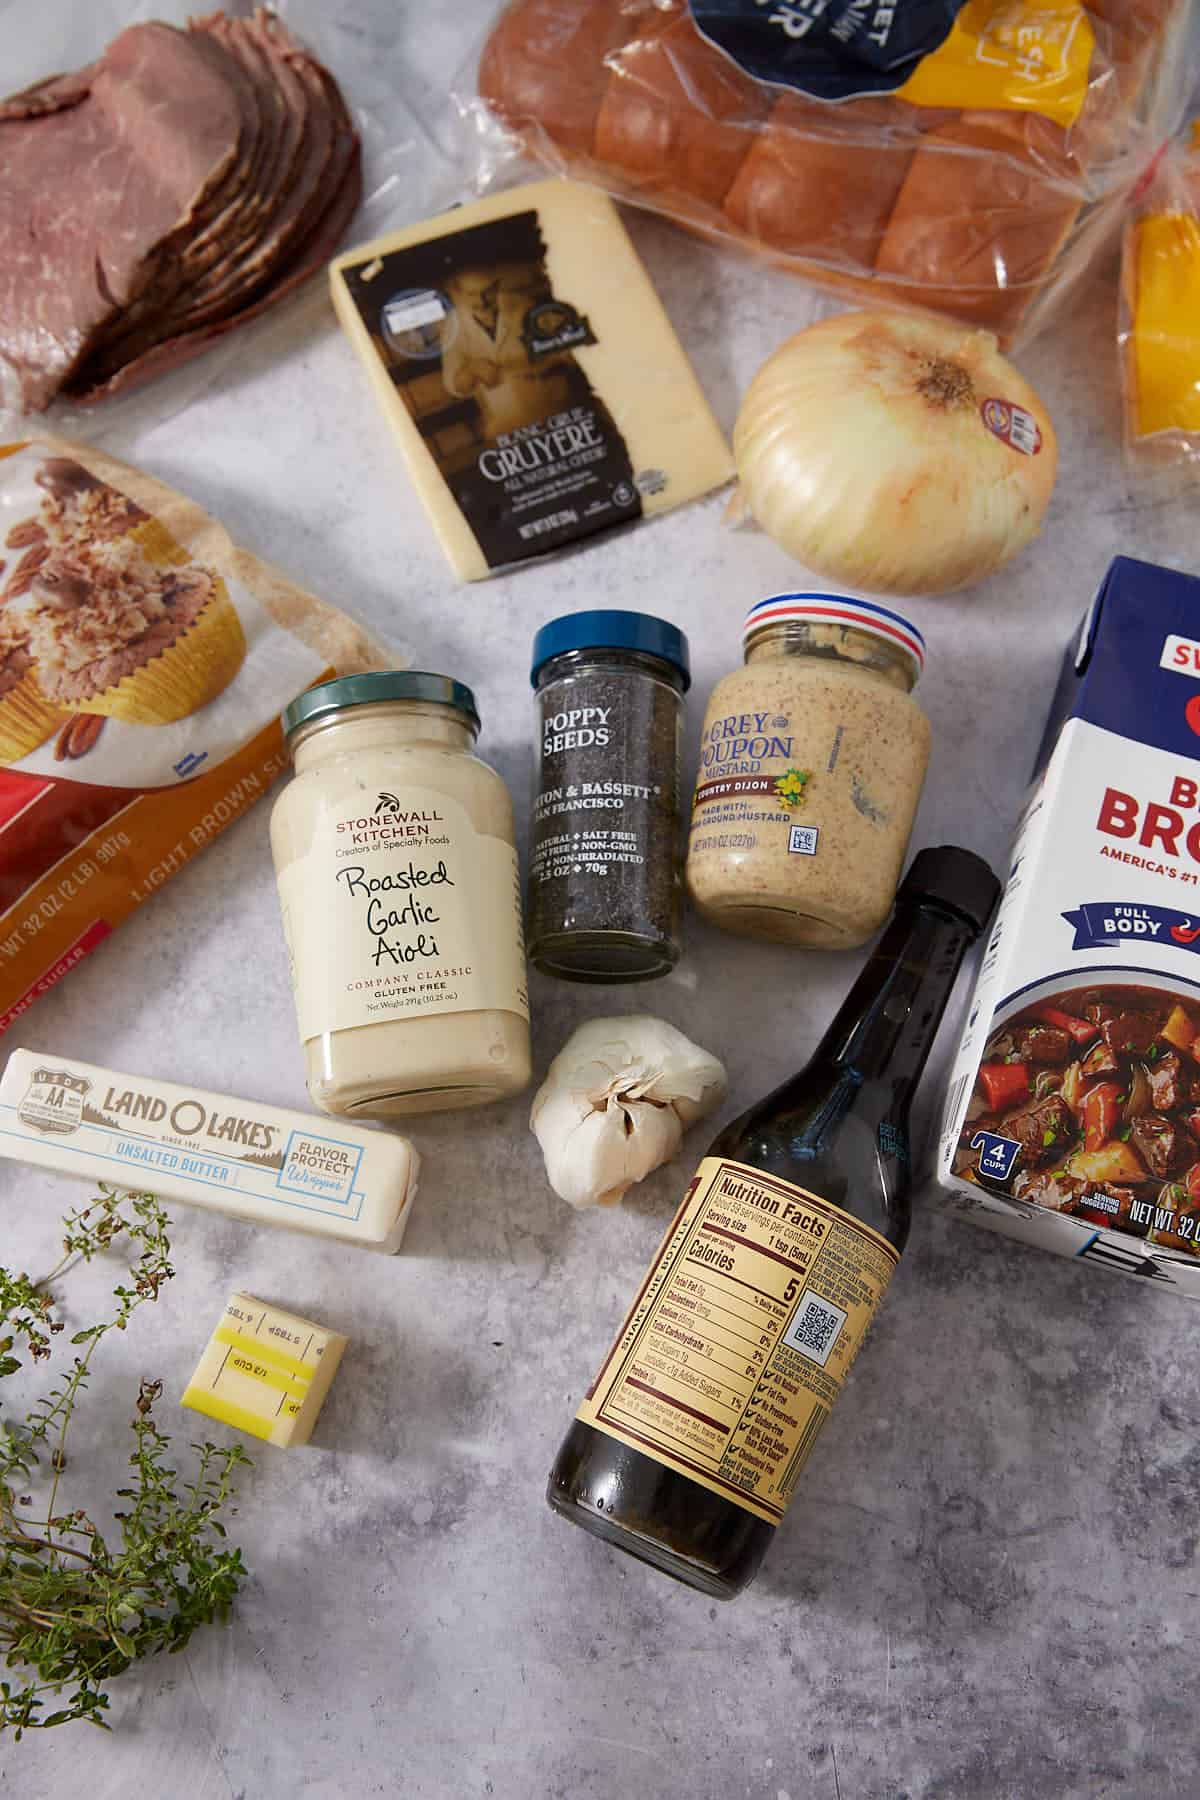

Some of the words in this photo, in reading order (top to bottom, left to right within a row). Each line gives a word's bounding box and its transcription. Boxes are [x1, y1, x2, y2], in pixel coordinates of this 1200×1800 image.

[544, 707, 611, 736] POPPY
[711, 712, 768, 742] GREY
[543, 727, 610, 757] SEEDS
[704, 736, 794, 767] OUPON
[566, 785, 578, 797] &
[698, 783, 731, 799] COUNTRY
[735, 781, 768, 790] DIJON
[552, 798, 624, 815] FRANCISCO
[724, 801, 747, 811] WITH
[336, 811, 444, 833] STONEWALL
[736, 812, 790, 823] MUSTARD
[131, 840, 188, 901] LIGHT
[189, 773, 260, 846] BROWN
[352, 825, 429, 844] KITCHEN
[583, 831, 609, 840] SALT
[611, 831, 637, 842] FREE
[336, 843, 370, 858] Creators
[373, 841, 381, 851] of
[383, 837, 423, 850] Specialty
[425, 835, 449, 845] Foods
[581, 841, 637, 851] NON-GMO
[553, 852, 643, 865] NON-IRRADIATED
[1100, 845, 1177, 879] AMERICA'S
[1180, 872, 1198, 885] #1
[336, 861, 455, 897] Roasted
[554, 866, 570, 877] OZ
[585, 863, 608, 875] 70g
[3, 934, 27, 957] WT
[23, 914, 46, 936] 32
[40, 895, 64, 918] OZ
[58, 878, 76, 901] (2
[72, 859, 100, 885] LB)
[96, 831, 131, 863] 907g
[367, 893, 440, 935] Garlic
[1114, 907, 1150, 919] FULL
[1104, 918, 1162, 935] BODY
[372, 935, 440, 966] Aioli
[37, 947, 85, 991] SUGAR
[347, 974, 410, 991] COMPANY
[417, 967, 472, 980] CLASSIC
[375, 985, 416, 998] GLUTEN
[420, 982, 447, 992] FREE
[379, 999, 404, 1011] Weight
[45, 1086, 64, 1108] AA
[102, 1087, 167, 1122] LAND
[170, 1100, 206, 1135] O
[207, 1112, 275, 1149] LAKES
[116, 1143, 178, 1168] UNSALTED
[181, 1159, 229, 1180] BUTTER
[299, 1142, 348, 1163] FLAVOR
[990, 1144, 1006, 1160] 4
[984, 1159, 1005, 1171] CUPS
[721, 1176, 780, 1214] Nutrition
[782, 1205, 826, 1236] Facts
[1080, 1196, 1119, 1214] SUGGESTION
[1094, 1192, 1120, 1206] SERVING
[707, 1208, 731, 1226] Serving
[731, 1218, 747, 1231] size
[739, 1207, 770, 1228] servings
[770, 1222, 783, 1234] per
[783, 1227, 818, 1250] container
[1130, 1200, 1154, 1224] NET
[1154, 1208, 1175, 1232] WT.
[1178, 1215, 1194, 1239] 32
[689, 1239, 735, 1271] Calories
[767, 1235, 774, 1244] 1
[774, 1239, 788, 1253] tsp
[789, 1246, 812, 1264] (5mL)
[621, 1303, 647, 1350] SHAKE
[647, 1274, 662, 1298] THE
[660, 1218, 689, 1270] BOTTLE
[687, 1281, 697, 1291] Fat
[782, 1278, 799, 1301] 5
[766, 1319, 779, 1331] 0%
[664, 1326, 704, 1350] Carbohydrate
[759, 1335, 772, 1347] 0%
[745, 1365, 757, 1377] 0%
[698, 1379, 722, 1397] Sugars
[767, 1387, 777, 1397] Fat
[775, 1392, 788, 1404] Free
[730, 1397, 743, 1408] 1%
[754, 1414, 784, 1435] Gluten-Free
[756, 1442, 767, 1455] Soy
[760, 1432, 774, 1445] Less
[740, 1465, 754, 1477] used
